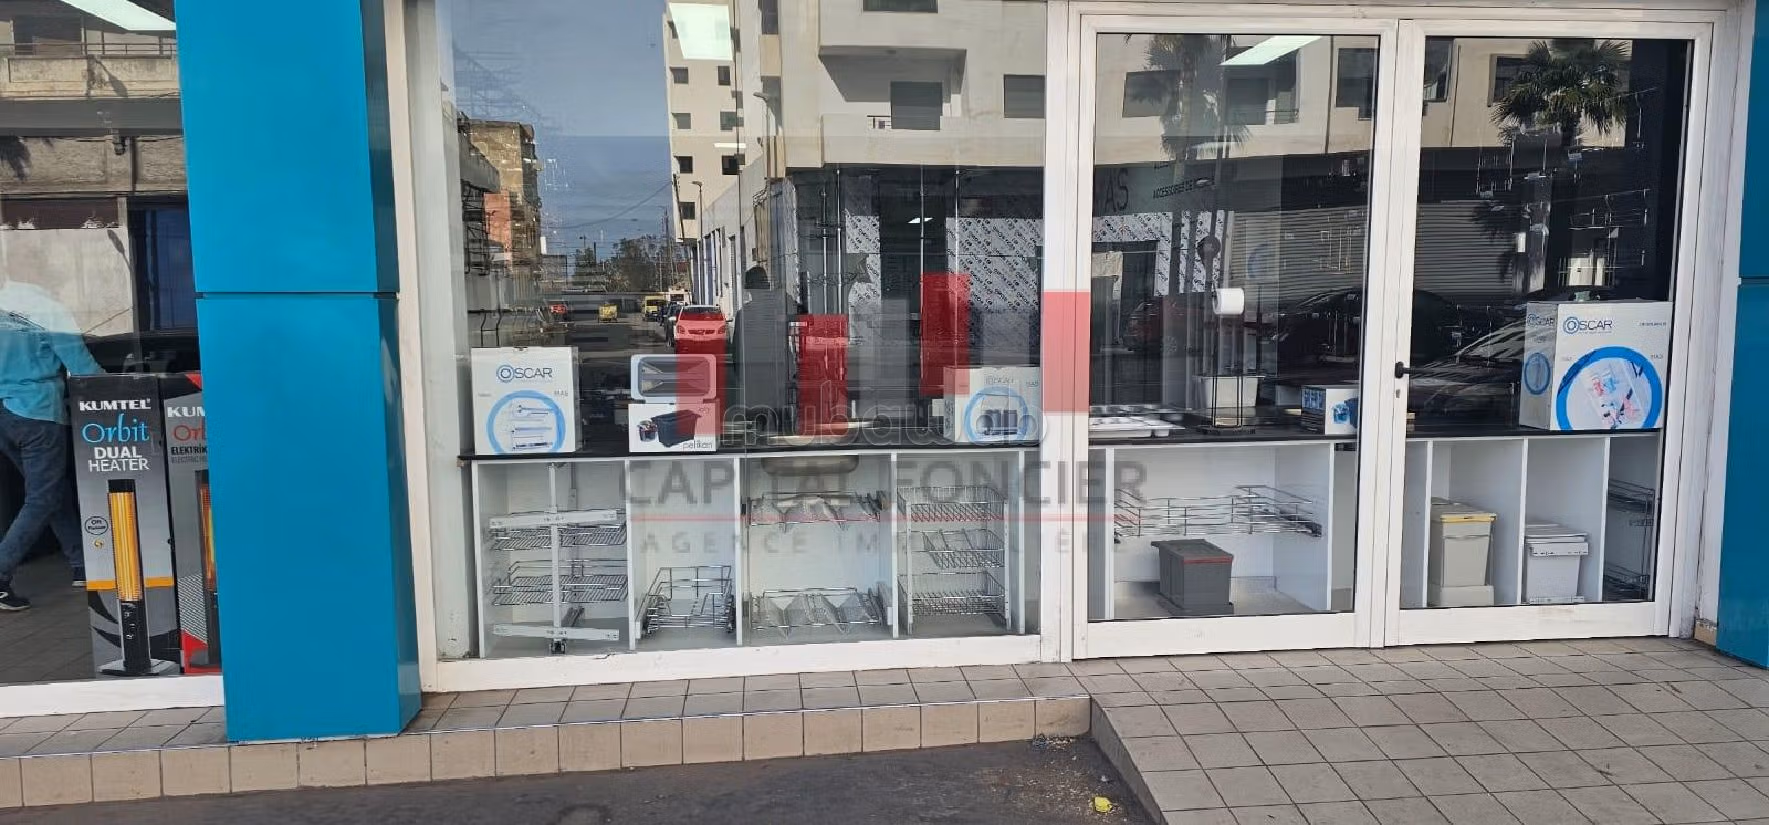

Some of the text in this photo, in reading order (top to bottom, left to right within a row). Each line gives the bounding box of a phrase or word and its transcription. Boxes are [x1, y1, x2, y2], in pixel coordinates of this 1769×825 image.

[1563, 316, 1613, 334] OSCAR
[496, 364, 553, 383] OSCAR
[79, 399, 152, 411] KUMTEL
[82, 413, 150, 443] Orbit
[94, 447, 142, 460] DUAL
[88, 459, 150, 473] HEATER
